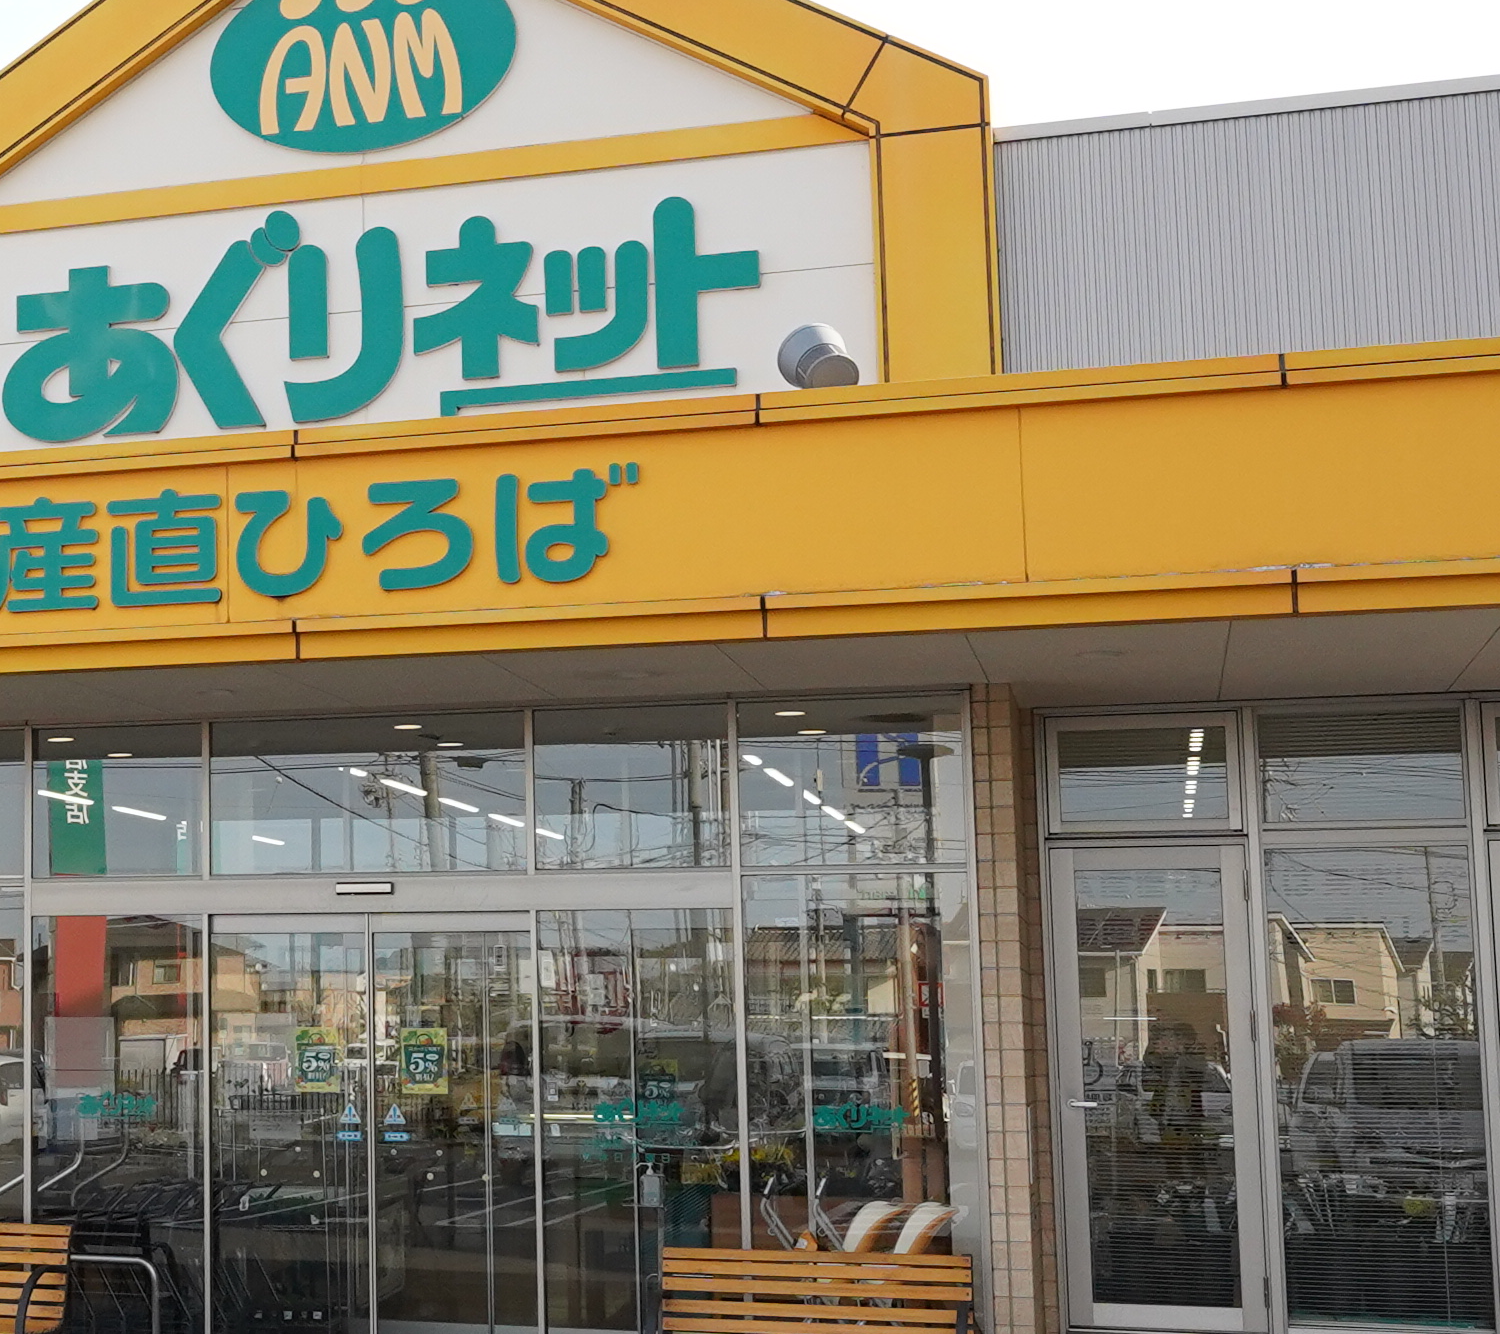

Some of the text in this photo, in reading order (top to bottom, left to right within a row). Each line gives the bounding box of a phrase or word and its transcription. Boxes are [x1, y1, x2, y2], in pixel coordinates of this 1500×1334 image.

[259, 7, 463, 135] ANM
[1, 195, 762, 443] あぐりネット
[302, 1051, 331, 1072] 5%
[409, 1052, 438, 1073] 5%
